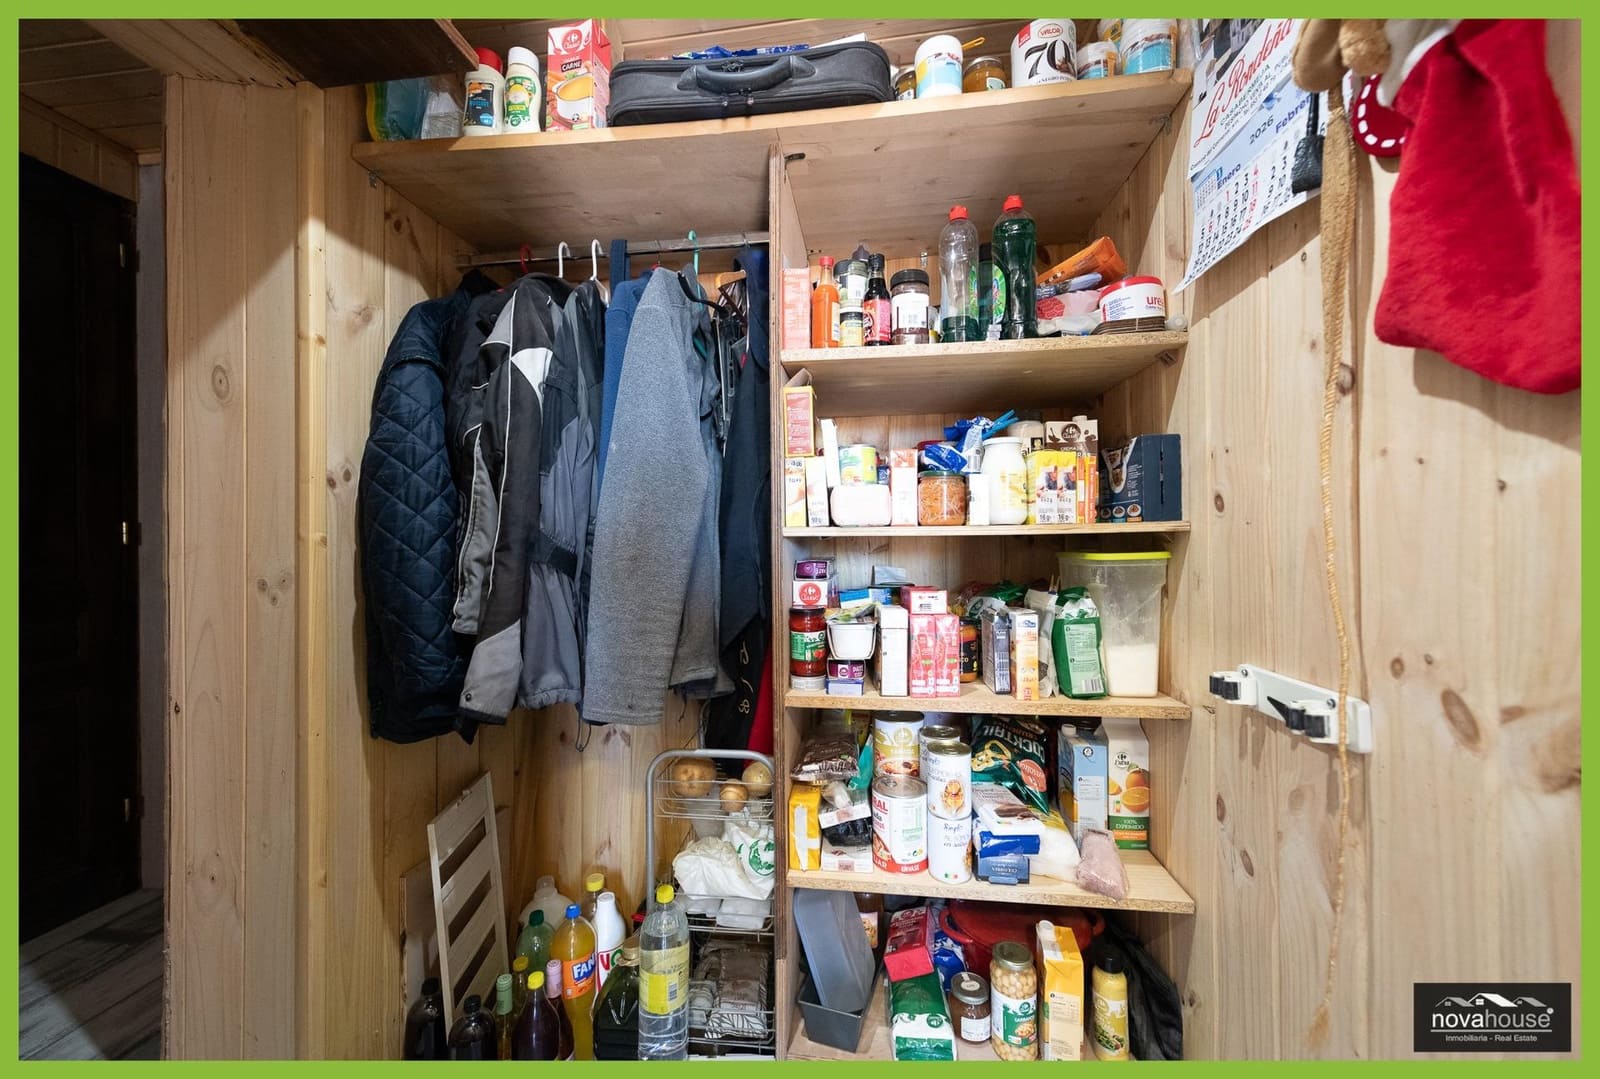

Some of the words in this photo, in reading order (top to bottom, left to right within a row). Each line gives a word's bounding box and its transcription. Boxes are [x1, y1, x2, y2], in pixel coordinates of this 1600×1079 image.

[1040, 27, 1061, 37] VALOR
[562, 61, 582, 71] CARNE
[1193, 82, 1225, 148] La
[1276, 92, 1312, 134] Febrer
[1249, 114, 1275, 145] 2026
[1217, 163, 1241, 190] Enero
[983, 724, 1046, 763] COCKTAIL
